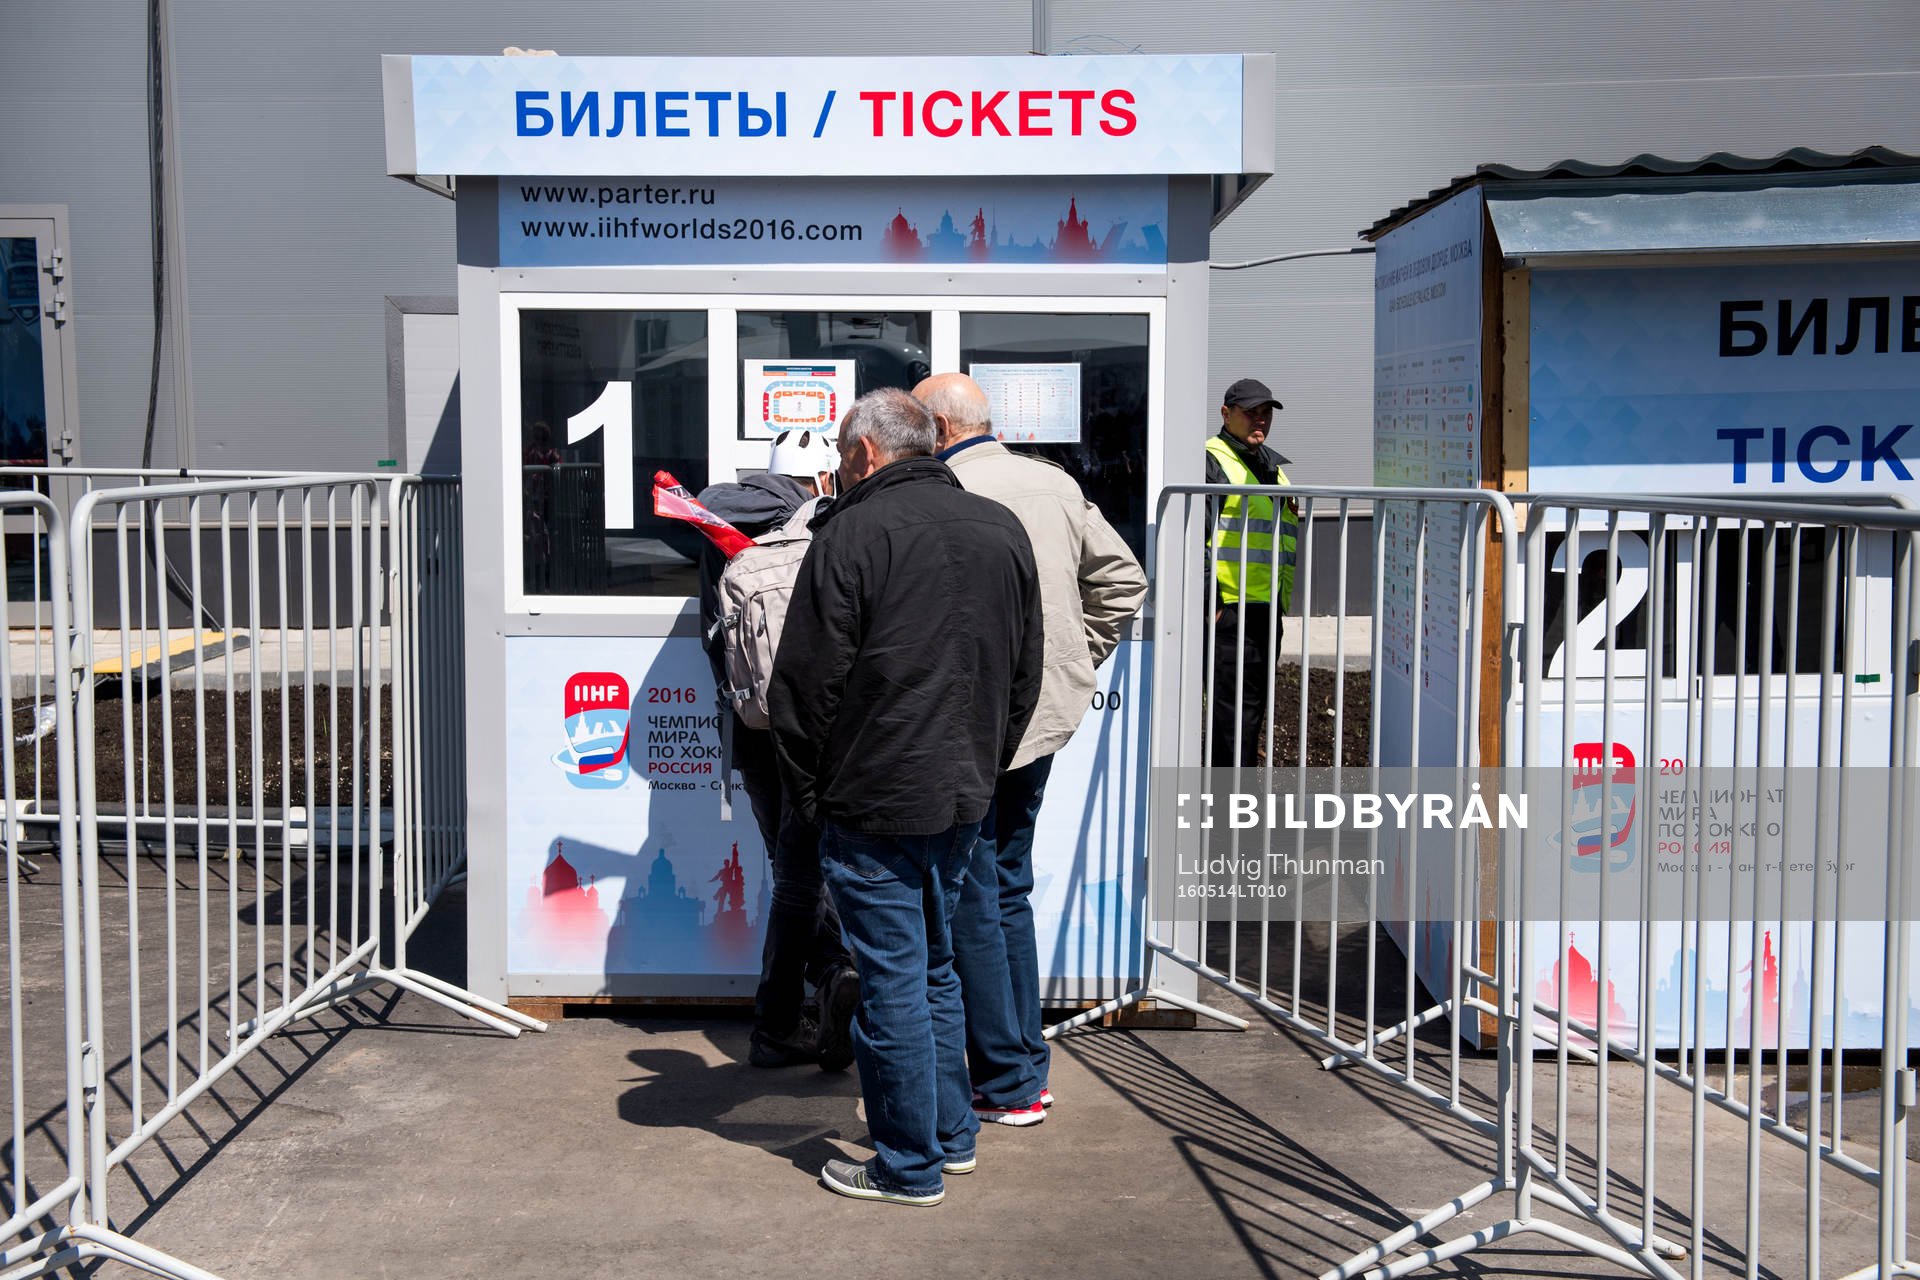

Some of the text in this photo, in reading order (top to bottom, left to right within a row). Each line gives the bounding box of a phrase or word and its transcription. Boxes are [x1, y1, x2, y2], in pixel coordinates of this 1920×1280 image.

[515, 89, 1138, 138] БИЛЕТЫ / TICKETS
[521, 184, 715, 208] www.parter.ru
[521, 217, 862, 241] www.iihfworlds2016.com
[567, 380, 634, 529] 1
[1717, 424, 1914, 484] TICK
[1547, 530, 1650, 678] 2
[574, 685, 619, 702] IIHF
[648, 687, 696, 703] 2016
[648, 715, 722, 729] ЧЕМПИО
[648, 731, 700, 743] МИРА
[649, 745, 723, 759] ПО ХОК
[648, 762, 712, 774] РОССИЯ
[1659, 758, 1687, 776] 20
[649, 780, 696, 791] Москва
[1658, 823, 1686, 837] ПО
